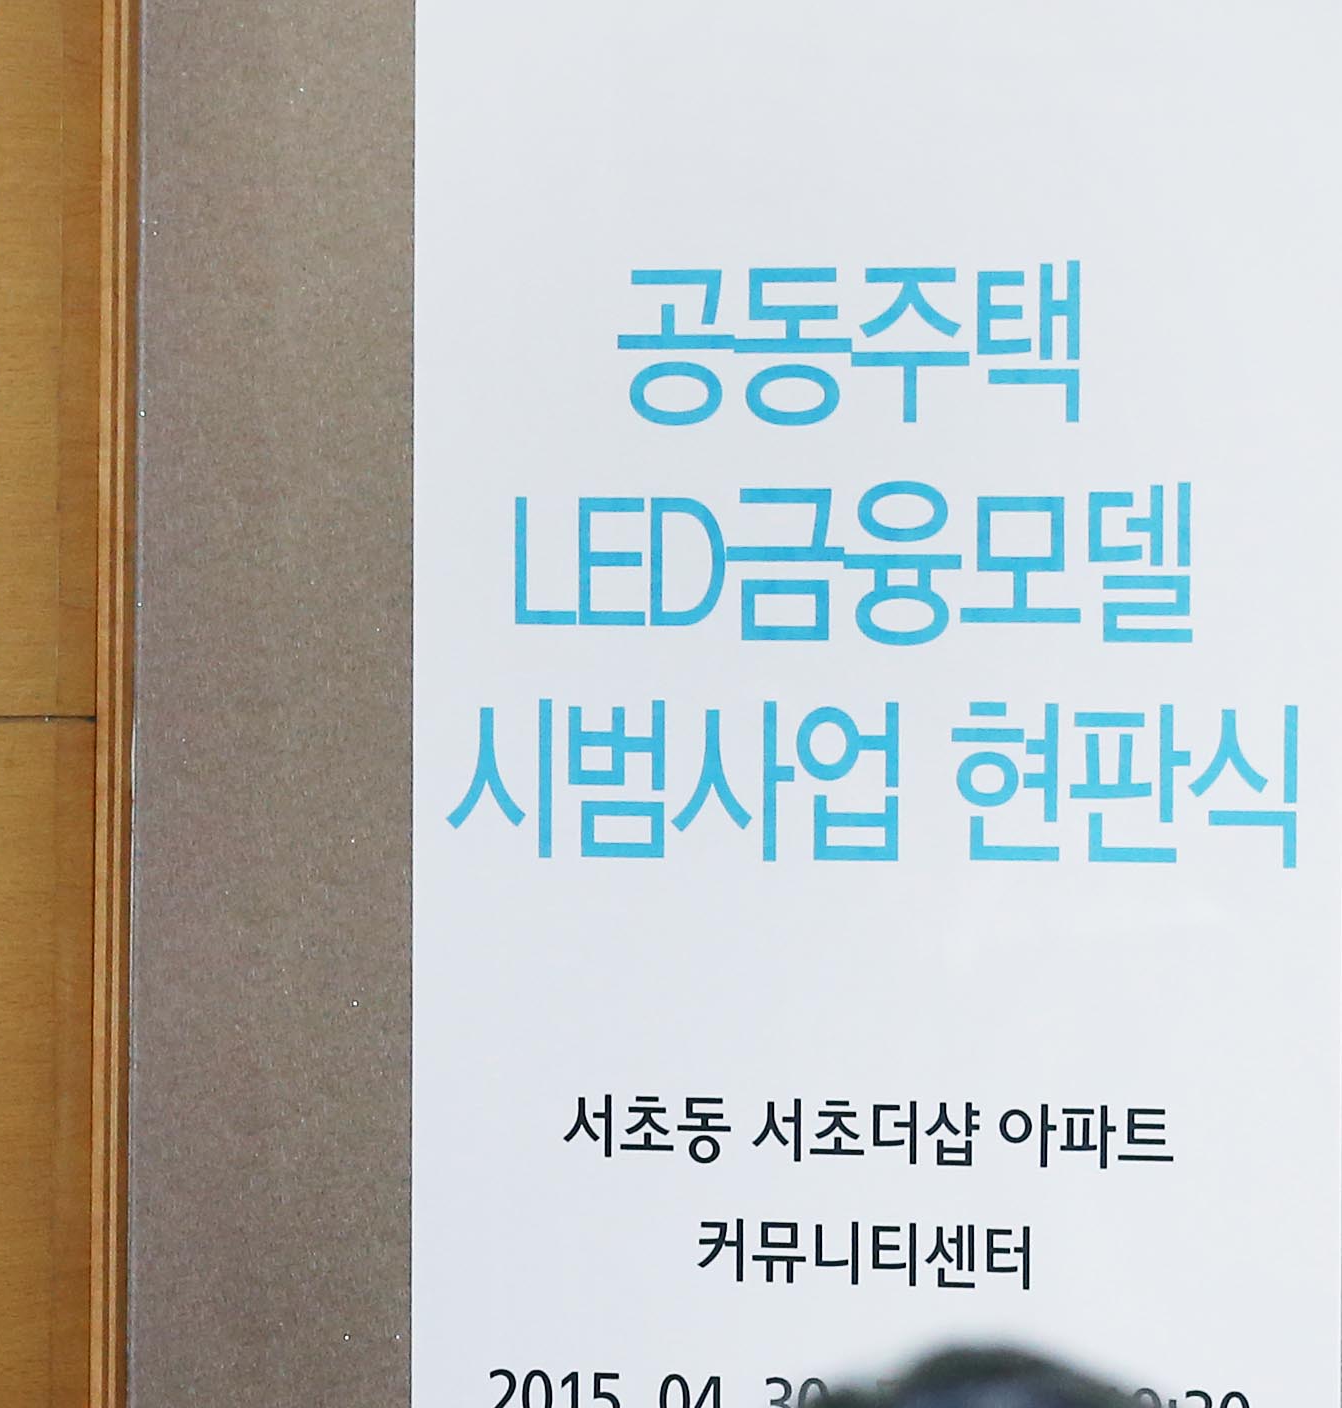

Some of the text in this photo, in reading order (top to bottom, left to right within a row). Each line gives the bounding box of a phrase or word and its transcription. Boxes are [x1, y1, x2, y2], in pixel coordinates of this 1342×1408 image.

[617, 260, 1082, 426] 공동주택
[514, 480, 1193, 646] LED금융모델
[446, 698, 1299, 869] 시범사업 현판식
[563, 1093, 1175, 1170] 서초동 서초더샵 아파트
[697, 1218, 1035, 1291] 커뮤니티센터
